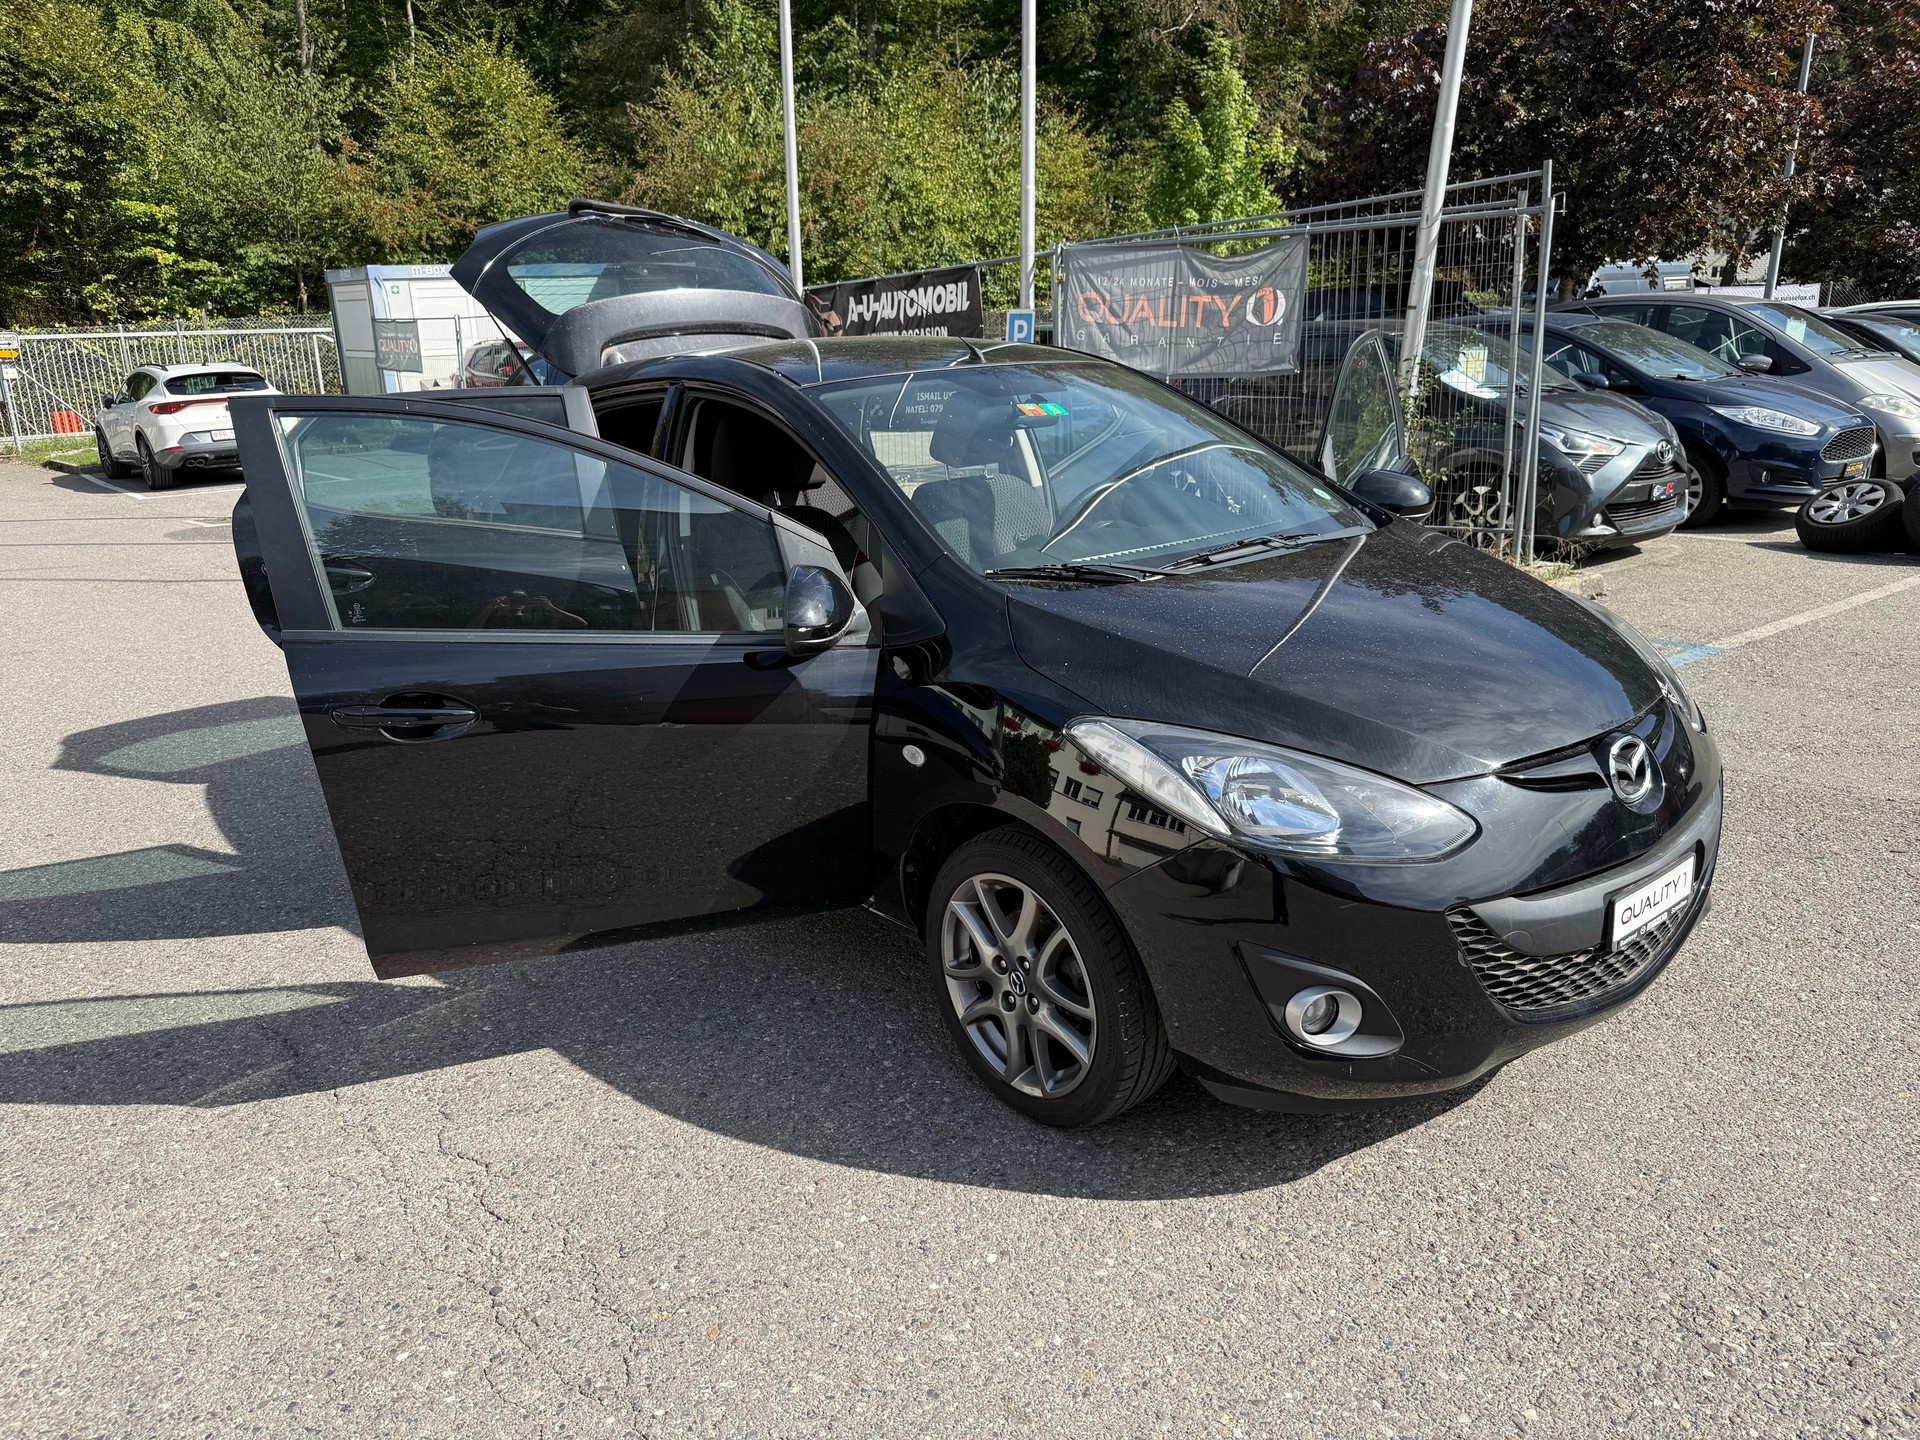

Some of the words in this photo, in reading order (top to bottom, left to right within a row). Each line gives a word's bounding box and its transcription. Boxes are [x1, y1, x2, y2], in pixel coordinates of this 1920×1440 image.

[1130, 277, 1174, 287] MONATE
[1189, 278, 1218, 288] MOIS
[845, 281, 970, 329] A-U-AUTOMOBIL
[1078, 291, 1242, 328] QUALITY
[1013, 319, 1028, 342] P
[1076, 330, 1282, 348] GARANTIE
[916, 391, 942, 401] ISMAIL
[905, 405, 929, 414] NATEL:
[930, 404, 944, 413] 079
[1621, 875, 1681, 925] QUALITY
